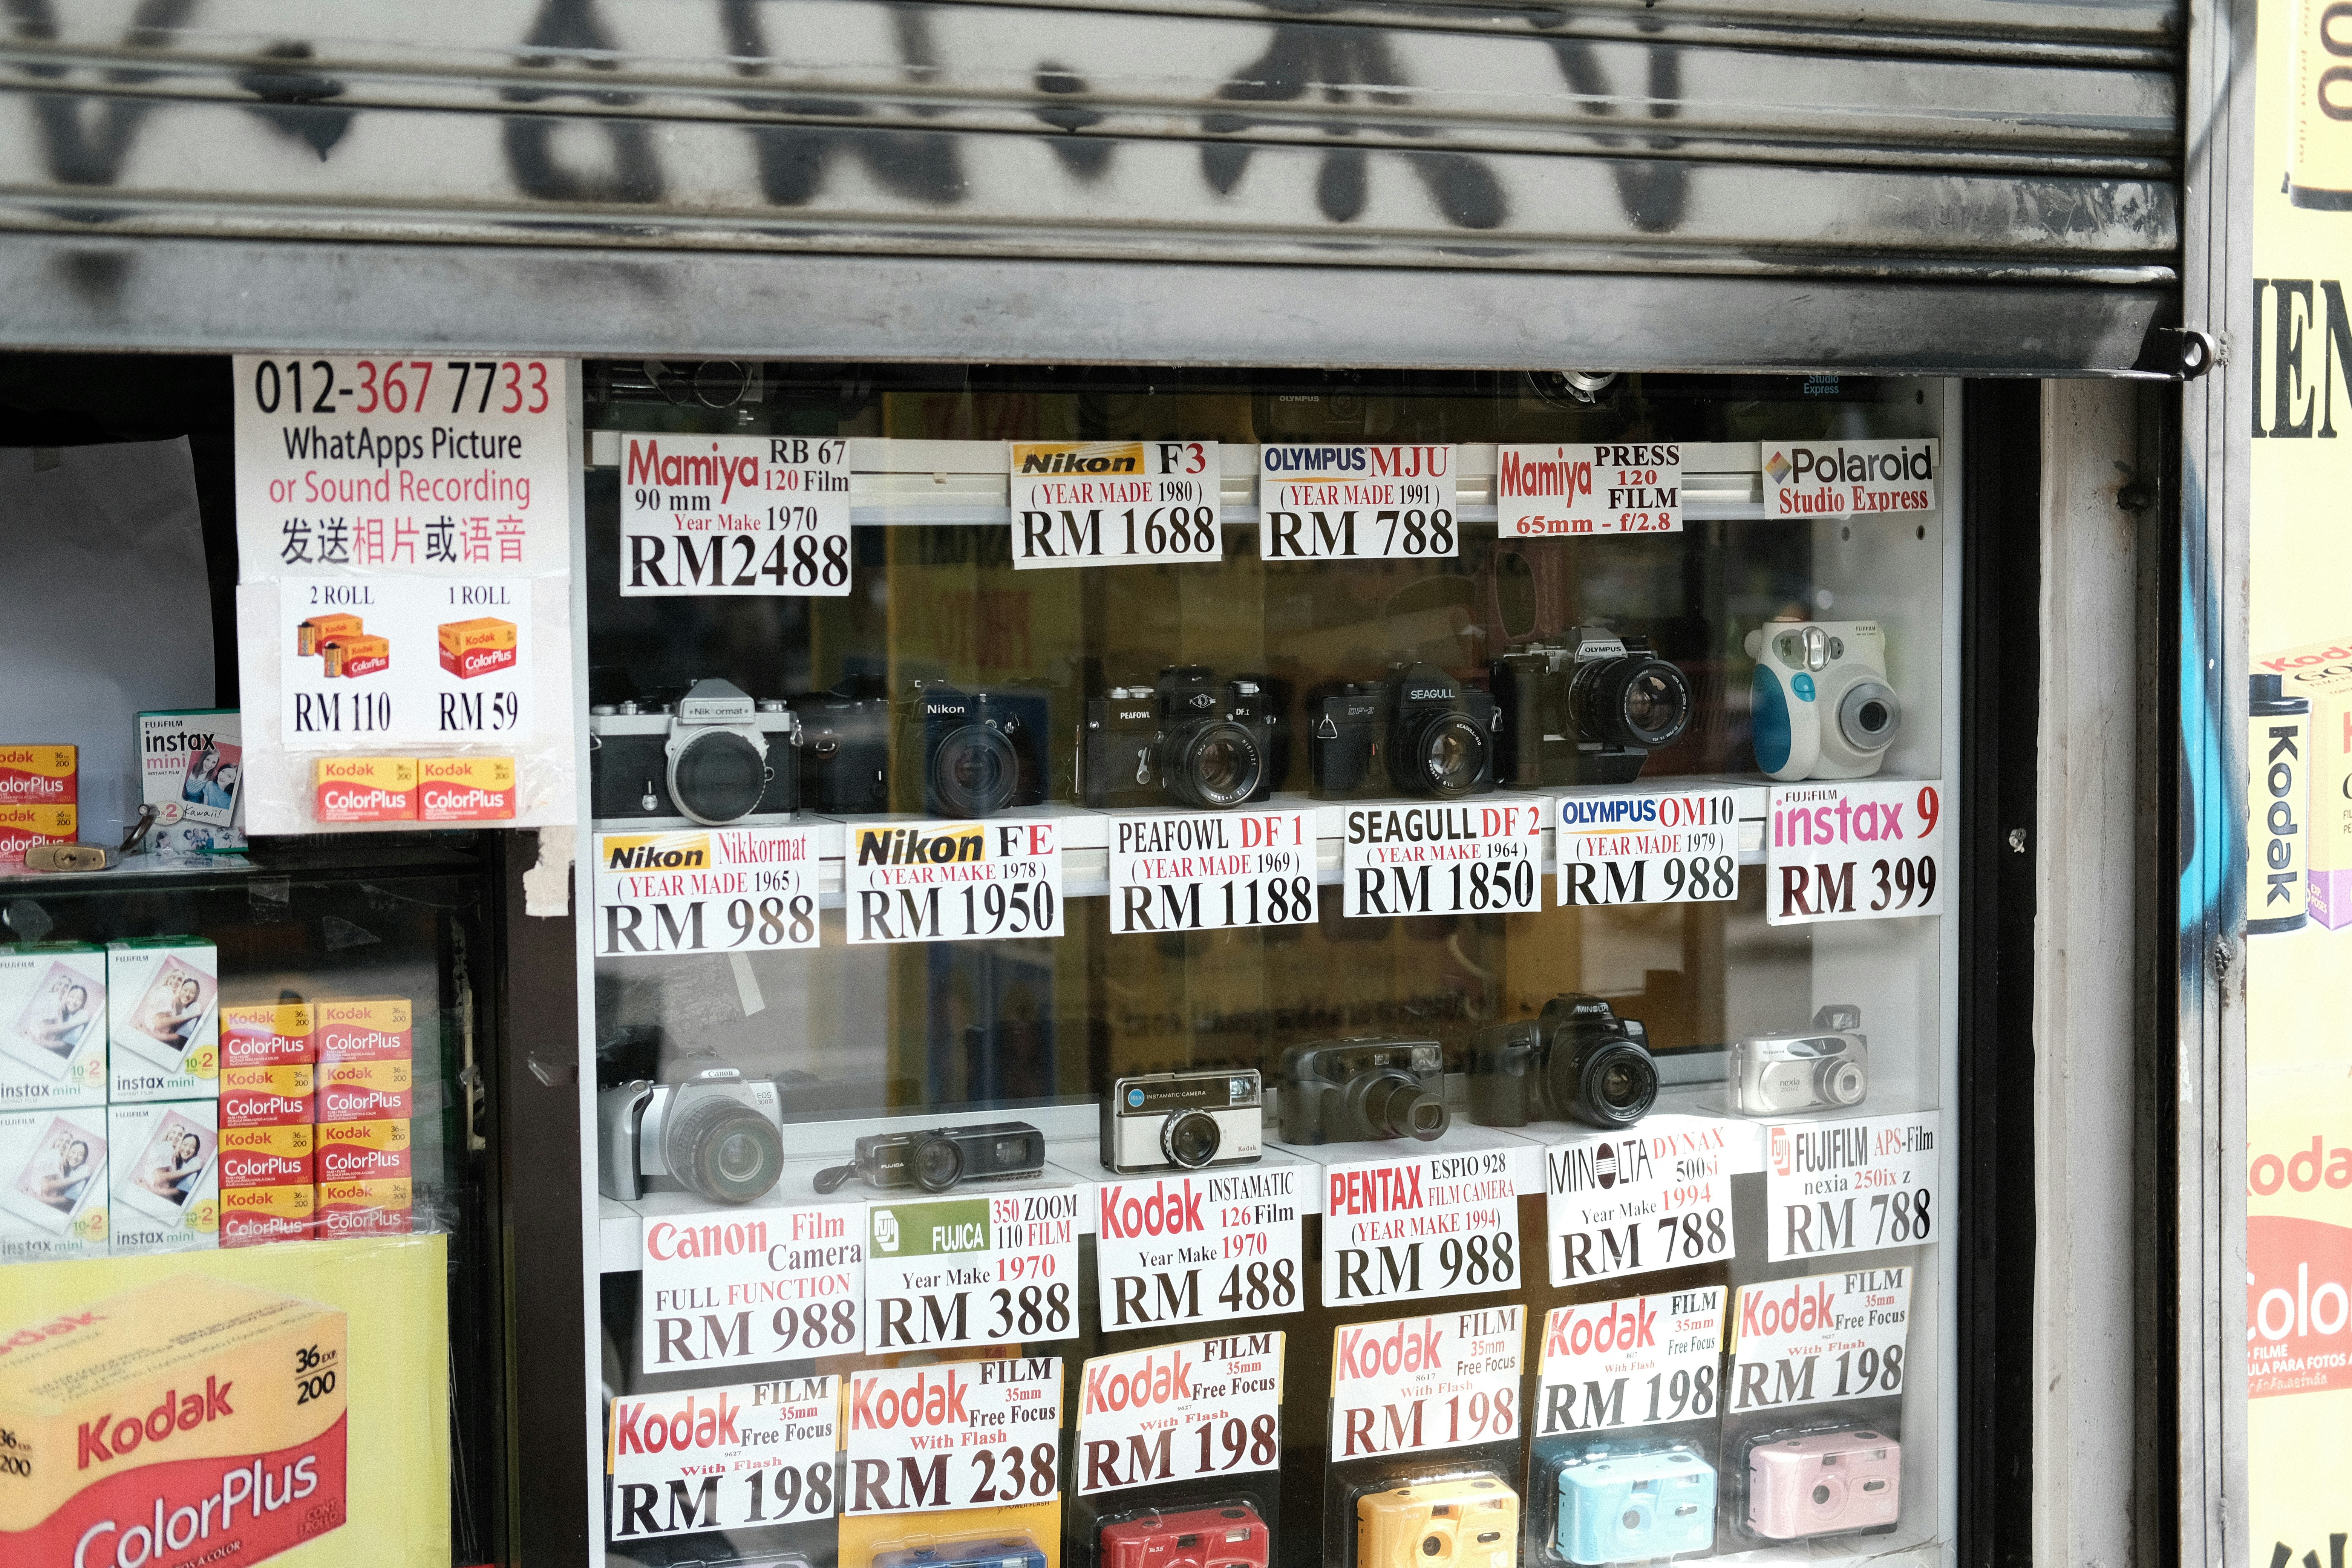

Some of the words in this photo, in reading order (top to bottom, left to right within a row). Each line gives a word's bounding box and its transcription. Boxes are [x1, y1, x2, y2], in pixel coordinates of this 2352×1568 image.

[256, 360, 433, 413] 012-367
[448, 361, 548, 413] 7733
[1804, 383, 1839, 396] Express
[1809, 375, 1839, 383] Studio
[283, 426, 423, 467] WhatApps
[433, 427, 521, 459] Picture
[769, 439, 808, 464] RB
[818, 441, 846, 464] 67
[1021, 454, 1136, 475] Nikon
[1158, 443, 1206, 474] F3
[1369, 448, 1449, 477] MJU
[1594, 445, 1680, 466] PRESS
[1793, 446, 1932, 484] Polaroid
[270, 479, 296, 502] or
[305, 469, 389, 502] Sound
[401, 469, 529, 510] Recording
[628, 439, 758, 504] Mamiya
[764, 470, 798, 490] 120
[804, 471, 848, 491] Film
[1501, 447, 1592, 508] Mamiya
[1617, 470, 1657, 485] 120
[635, 489, 660, 510] 90
[669, 495, 710, 510] mm
[1608, 487, 1678, 509] FILM
[1779, 487, 1844, 514] Studio
[1852, 485, 1928, 511] Express
[674, 514, 712, 530] Year
[718, 514, 761, 530] Make
[767, 507, 817, 531] 1970
[1020, 510, 1103, 557] RM
[1122, 507, 1215, 554] 1688
[1265, 511, 1359, 557] RM
[1375, 510, 1453, 556] 788
[1516, 516, 1592, 533] 65mm
[1619, 512, 1671, 531] f/2.8
[281, 515, 525, 565] 发送相片或语音
[627, 535, 848, 586] RM2488
[311, 587, 317, 604] 2
[325, 587, 375, 604] ROLL
[450, 587, 454, 604] 1
[462, 586, 510, 604] ROLL
[294, 693, 340, 731] RM
[351, 692, 390, 731] 110
[439, 693, 484, 730] RM
[493, 692, 518, 730] 59
[928, 705, 965, 713] Nikon
[1411, 689, 1455, 699] SEAGULL
[145, 730, 214, 752] instax
[147, 755, 186, 769] mini
[1659, 796, 1733, 827] OM10
[1785, 790, 1837, 802] FUJIFILM
[1119, 819, 1228, 853] PEAFOWL
[1239, 816, 1281, 848] DF
[1292, 815, 1303, 845] 1
[1349, 807, 1476, 844] SEAGULL
[1481, 807, 1519, 837] DF
[1528, 806, 1540, 835] 2
[1775, 795, 1903, 847] instax
[1917, 786, 1939, 838] 9
[2267, 725, 2298, 907] Kodak
[610, 846, 703, 869] Nikon
[718, 831, 806, 864] Nikkormat
[858, 829, 984, 865] Nikon
[996, 825, 1054, 856] FE
[1355, 865, 1432, 915] RM
[1448, 860, 1533, 910] 1850
[1563, 860, 1649, 905] RM
[1663, 855, 1733, 900] 988
[1779, 862, 1857, 917] RM
[1871, 855, 1936, 911] 399
[857, 887, 944, 940] RM
[960, 880, 1054, 935] 1950
[1120, 883, 1204, 931] RM
[1220, 876, 1311, 925] 1188
[601, 902, 708, 953] RM
[727, 896, 814, 948] 988
[708, 1069, 733, 1078] Canon
[226, 1131, 271, 1146] Kodak
[1653, 1127, 1724, 1159] DYNAX
[1796, 1126, 1867, 1172] FUJIFILM
[1874, 1126, 1933, 1156] APS-Film
[225, 1158, 301, 1176] ColorPlus
[1431, 1155, 1478, 1180] ESPIO
[1483, 1153, 1505, 1174] 928
[1549, 1139, 1652, 1195] MINOLTA
[1676, 1154, 1718, 1182] 500si
[1805, 1174, 1848, 1194] nexia
[1854, 1169, 1897, 1190] 250ix
[1208, 1171, 1294, 1202] INSTAMATIC
[1331, 1165, 1423, 1216] PENTAX
[1429, 1184, 1459, 1207] FILM
[1463, 1178, 1514, 1202] CAMERA
[792, 1213, 845, 1241] Film
[994, 1199, 1019, 1223] 350
[1024, 1194, 1078, 1221] ZOOM
[1101, 1178, 1205, 1239] Kodak
[1220, 1206, 1251, 1227] 126
[1254, 1204, 1294, 1225] Film
[1784, 1198, 1857, 1256] RM
[1870, 1188, 1930, 1245] 788
[648, 1221, 767, 1260] Canon
[933, 1223, 984, 1251] FUJICA
[997, 1224, 1022, 1249] 110
[1028, 1220, 1071, 1246] FILM
[1559, 1223, 1643, 1280] RM
[1658, 1208, 1726, 1262] 788
[768, 1243, 862, 1271] Camera
[1335, 1242, 1424, 1299] RM
[1440, 1231, 1514, 1289] 988
[655, 1287, 720, 1311] FULL
[729, 1273, 850, 1306] FUNCTION
[1111, 1269, 1203, 1326] RM
[1219, 1258, 1295, 1312] 488
[1742, 1282, 1836, 1338] Kodak
[654, 1311, 754, 1364] RM
[772, 1300, 856, 1353] 988
[876, 1292, 972, 1348] RM
[988, 1282, 1070, 1338] 388
[296, 1344, 320, 1374] 36
[2254, 1344, 2288, 1360] FILME
[2273, 1358, 2305, 1373] PARA
[2308, 1353, 2346, 1369] FOTOS
[296, 1371, 336, 1404] 200
[752, 1377, 829, 1407] FILM
[1735, 1355, 1819, 1409] RM
[1832, 1344, 1903, 1397] 198
[779, 1405, 818, 1421] 35mm
[852, 1369, 969, 1430] Kodak
[78, 1374, 233, 1470] Kodak
[619, 1392, 740, 1455] Kodak
[741, 1427, 779, 1447] Free
[785, 1421, 831, 1442] Focus
[850, 1454, 952, 1511] RM
[970, 1442, 1056, 1503] 238
[72, 1454, 317, 1568] ColorPlus
[617, 1475, 723, 1536] RM
[744, 1461, 832, 1523] 198
